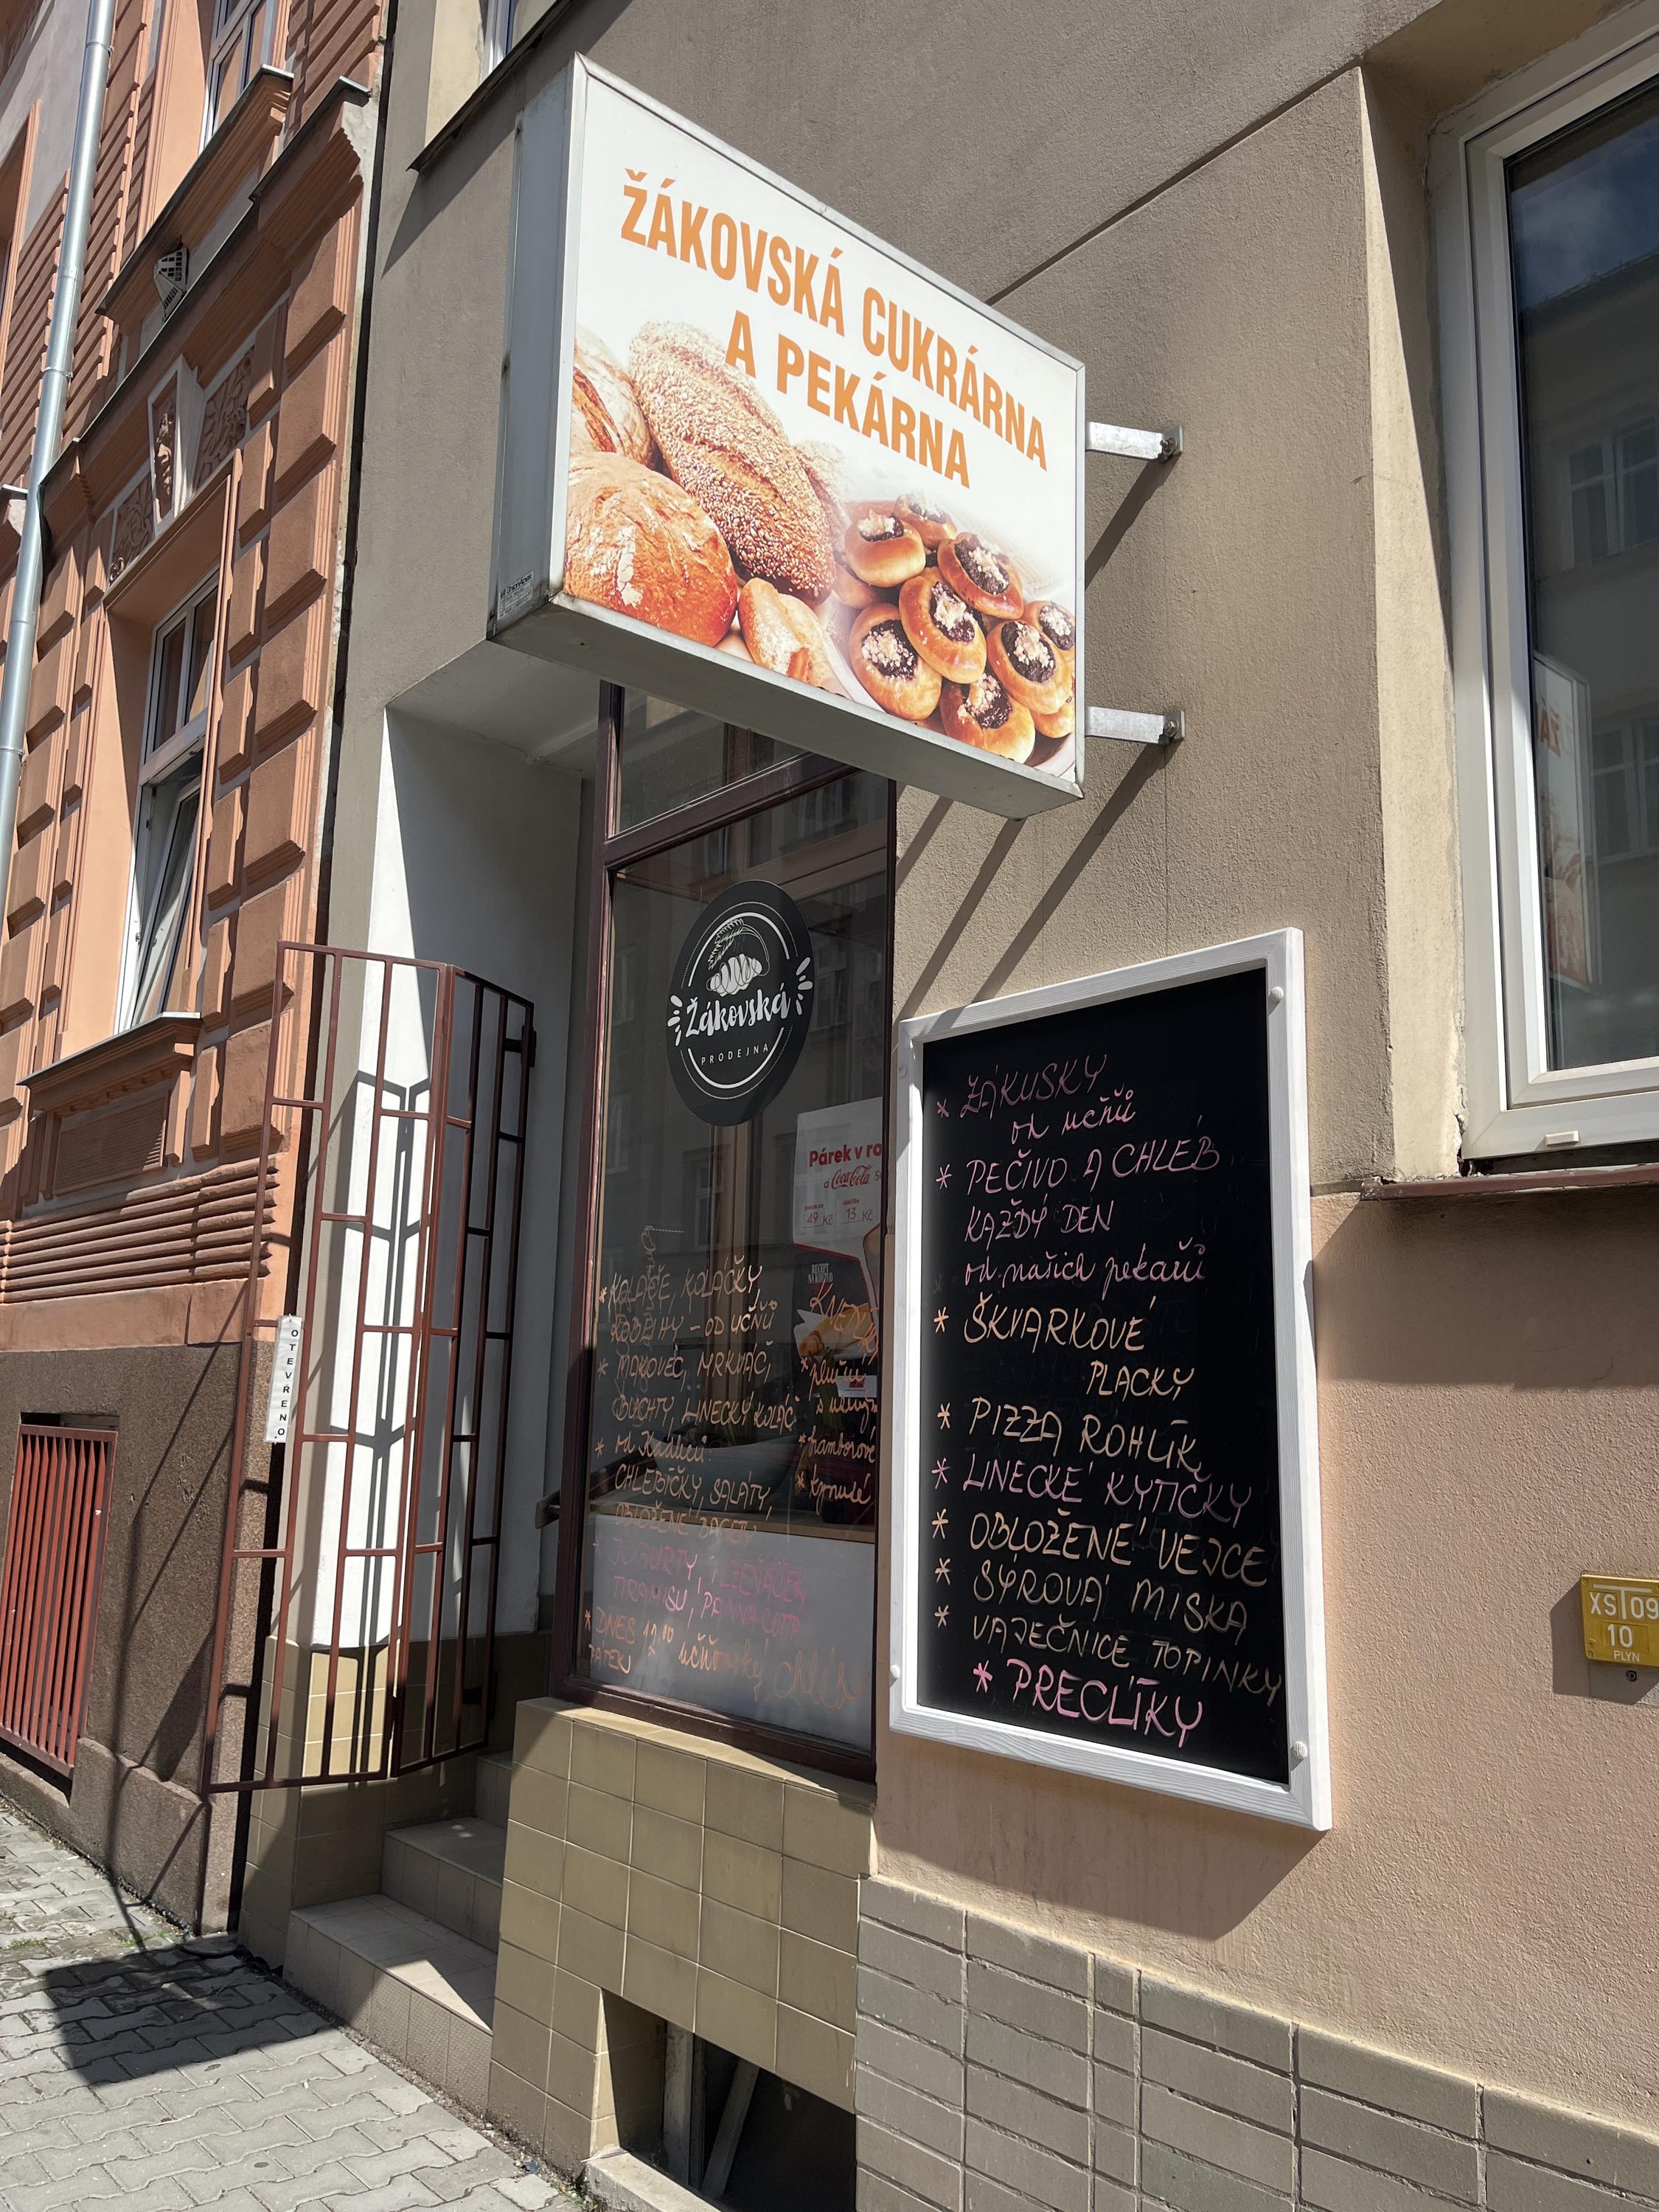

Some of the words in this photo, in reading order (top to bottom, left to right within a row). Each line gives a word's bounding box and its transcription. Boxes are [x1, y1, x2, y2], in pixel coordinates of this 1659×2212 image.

[620, 168, 845, 337] ŽÁKOVSKÁ
[861, 287, 1048, 472] CUKRÁRNA
[726, 310, 757, 378] A
[776, 333, 970, 489] PEKÁRNA
[686, 982, 790, 1037] Žákovská
[701, 1043, 768, 1065] PRODEJNA
[1012, 1113, 1049, 1145] od
[809, 1144, 852, 1167] Párek
[855, 1147, 863, 1160] v
[967, 1149, 1068, 1196] PEČIVO
[1083, 1149, 1102, 1192] A
[1062, 1200, 1115, 1236] DEN
[705, 1316, 724, 1337] OD
[277, 1329, 299, 1436] OTEVŘENO
[1086, 1360, 1194, 1401] PLACKY
[968, 1397, 1062, 1457] PIZZA
[970, 1508, 1147, 1565] OBLOŽENÉ
[1158, 1528, 1267, 1587] VEJCE
[596, 1607, 636, 1645] DNES
[1130, 1579, 1248, 1645] MISKA
[1607, 1624, 1633, 1648] 10
[1613, 1650, 1640, 1663] PLYN
[972, 1613, 1129, 1668] VAJEČNICE
[1152, 1640, 1282, 1706] TOPINKY
